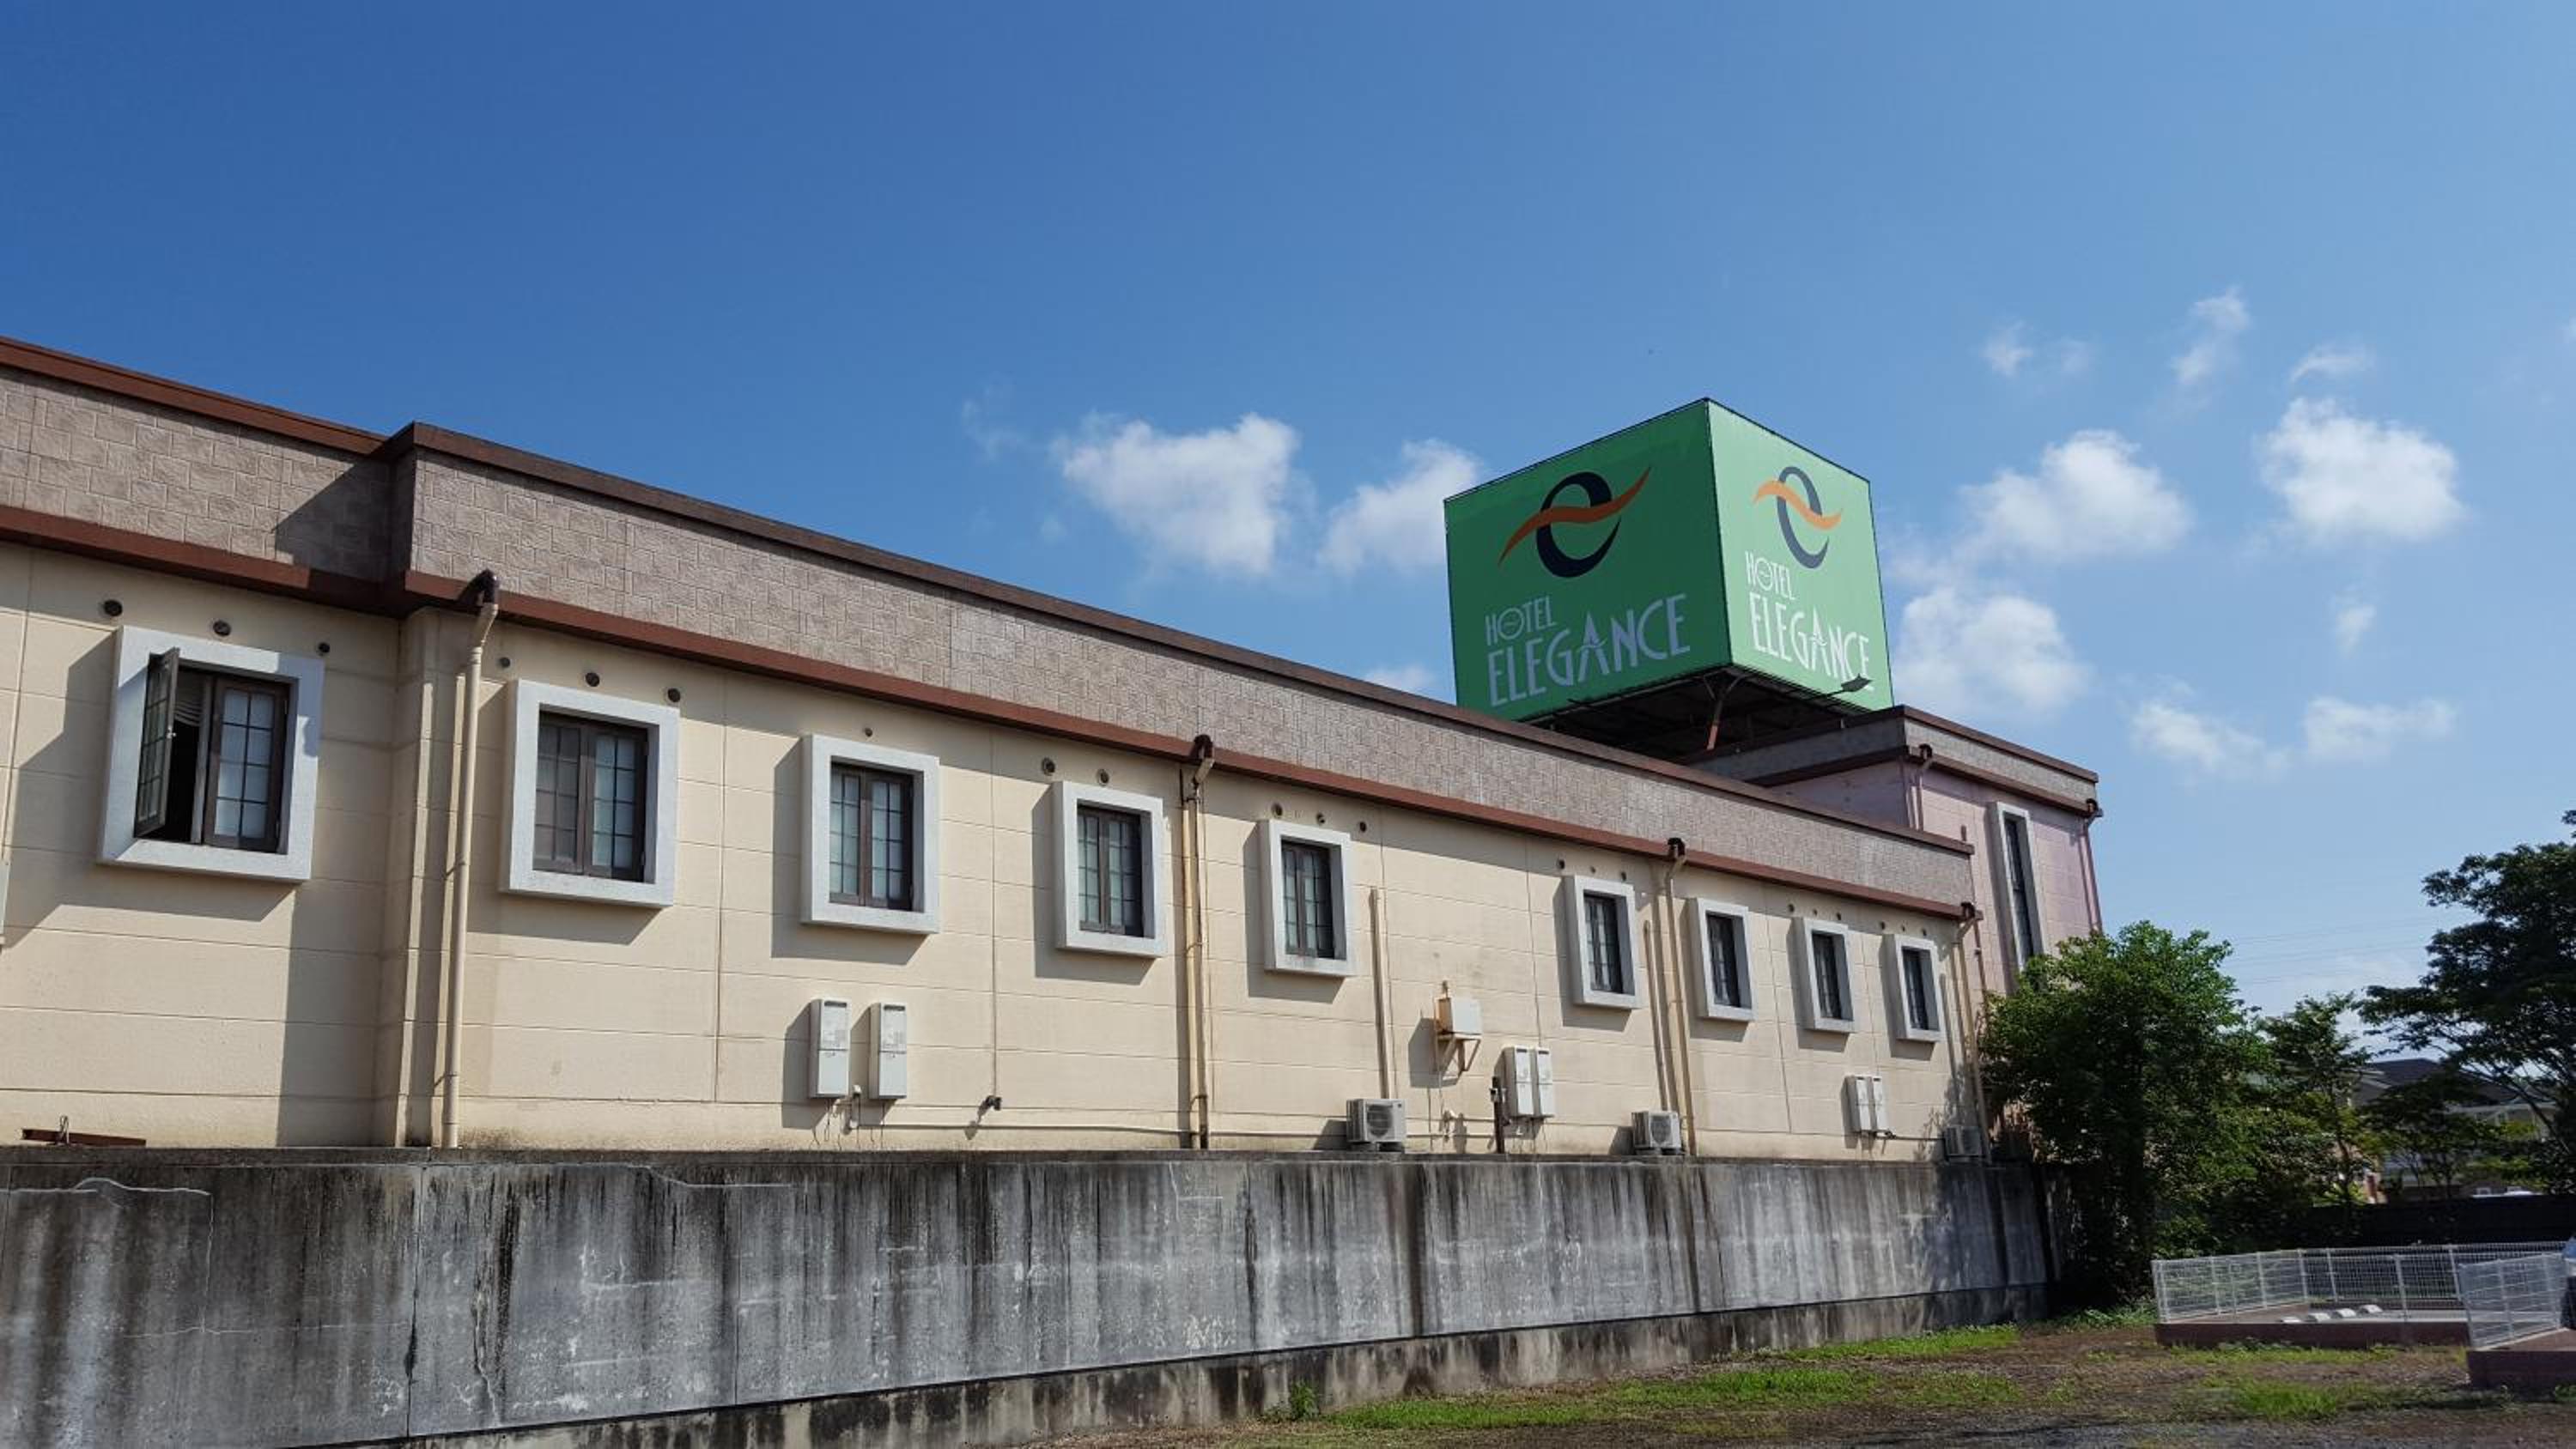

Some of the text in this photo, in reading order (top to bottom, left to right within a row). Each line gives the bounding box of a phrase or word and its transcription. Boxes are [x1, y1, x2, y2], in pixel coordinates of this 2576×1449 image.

[1744, 550, 1795, 601] HOTEL
[1485, 595, 1557, 646] HOTEL
[1487, 592, 1691, 707] ELEGANCE
[1748, 591, 1874, 691] ELEGANCE
